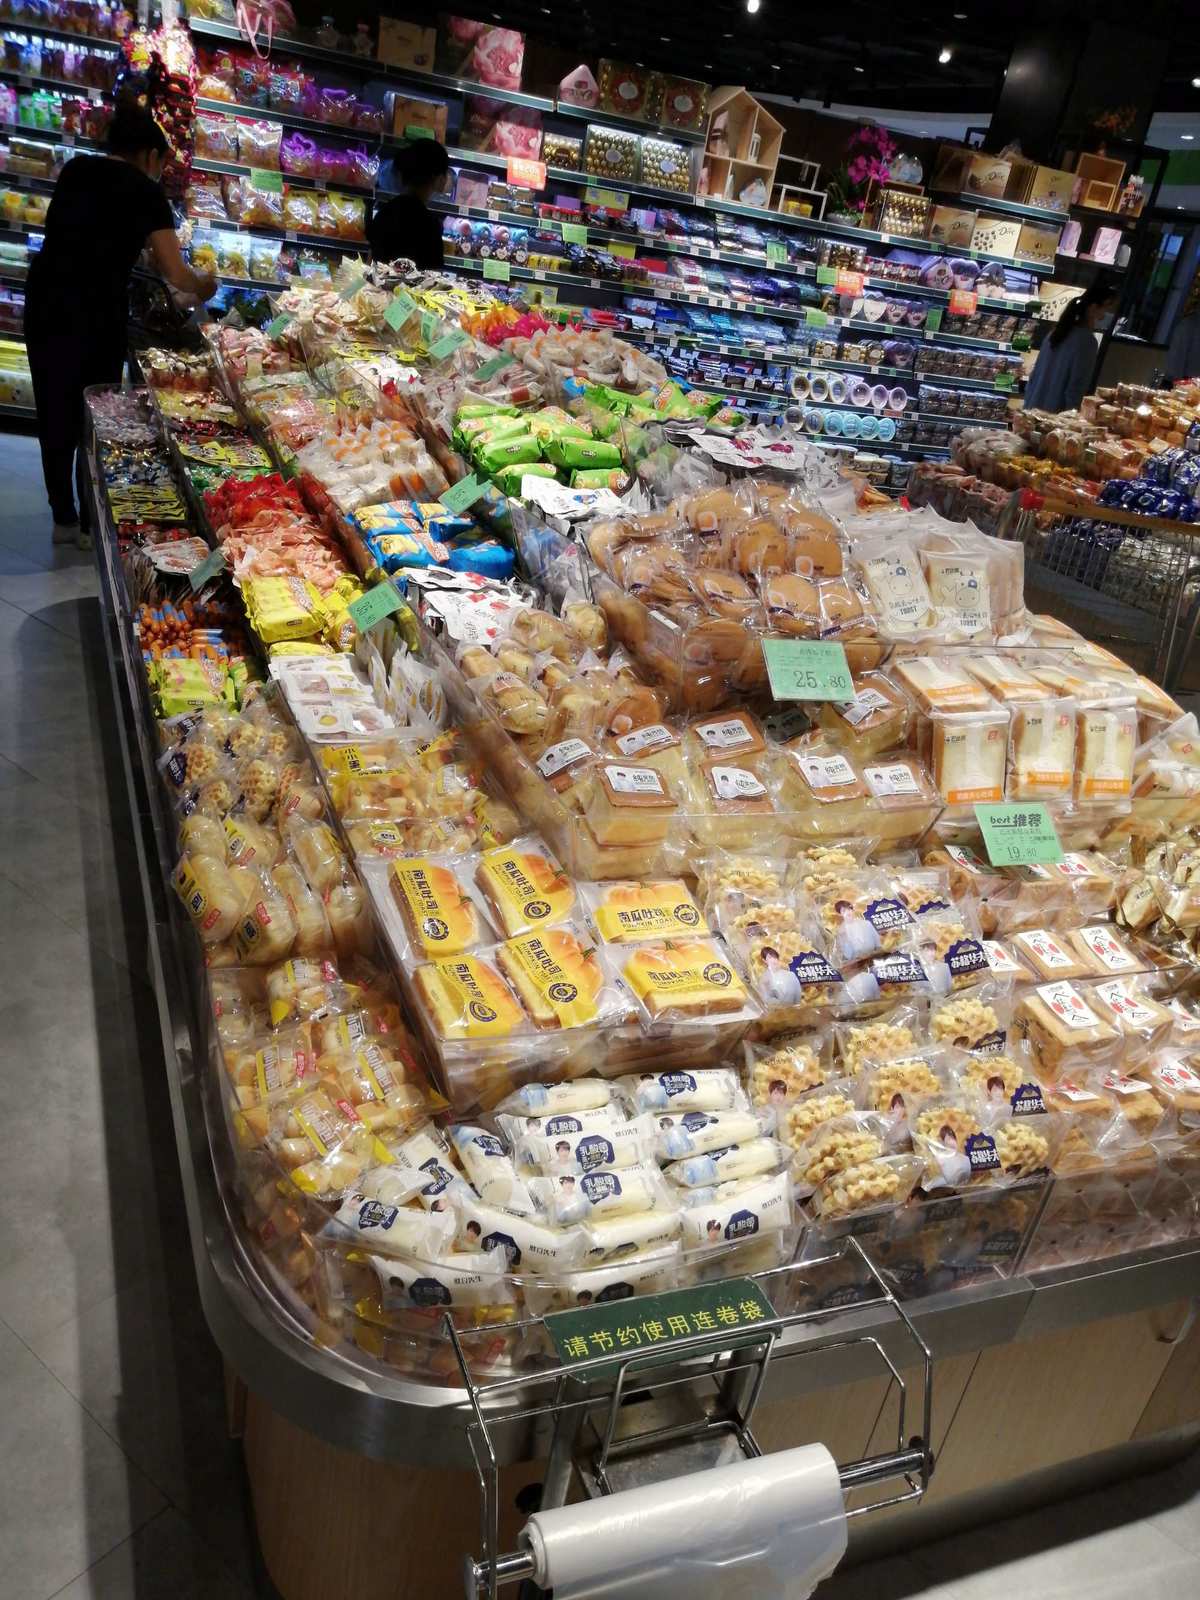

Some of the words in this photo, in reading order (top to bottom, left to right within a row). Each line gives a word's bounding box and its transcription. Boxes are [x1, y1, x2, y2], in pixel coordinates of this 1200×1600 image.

[793, 670, 847, 689] 25.80
[990, 815, 1011, 825] best
[1013, 813, 1042, 828] 推荐
[502, 860, 536, 896] 南瓜吐司
[411, 869, 440, 910] 南瓜吐司
[617, 907, 665, 924] 南瓜吐司
[871, 907, 909, 926] 苏格华夫
[527, 938, 562, 975] 南瓜吐司
[950, 951, 986, 969] 苏格华夫
[797, 964, 834, 979] 苏格华夫
[876, 964, 921, 979] 苏格华夫
[454, 963, 485, 999] 南瓜吐司
[662, 1074, 692, 1086] 乳酸菌
[1014, 1097, 1046, 1112] 苏格华夫
[580, 1142, 609, 1157] 乳酸菌
[970, 1146, 1001, 1165] 苏格华夫
[585, 1173, 616, 1188] 乳酸菌
[728, 1216, 756, 1235] 乳酸菌
[563, 1299, 766, 1358] 请节约使用连卷袋
